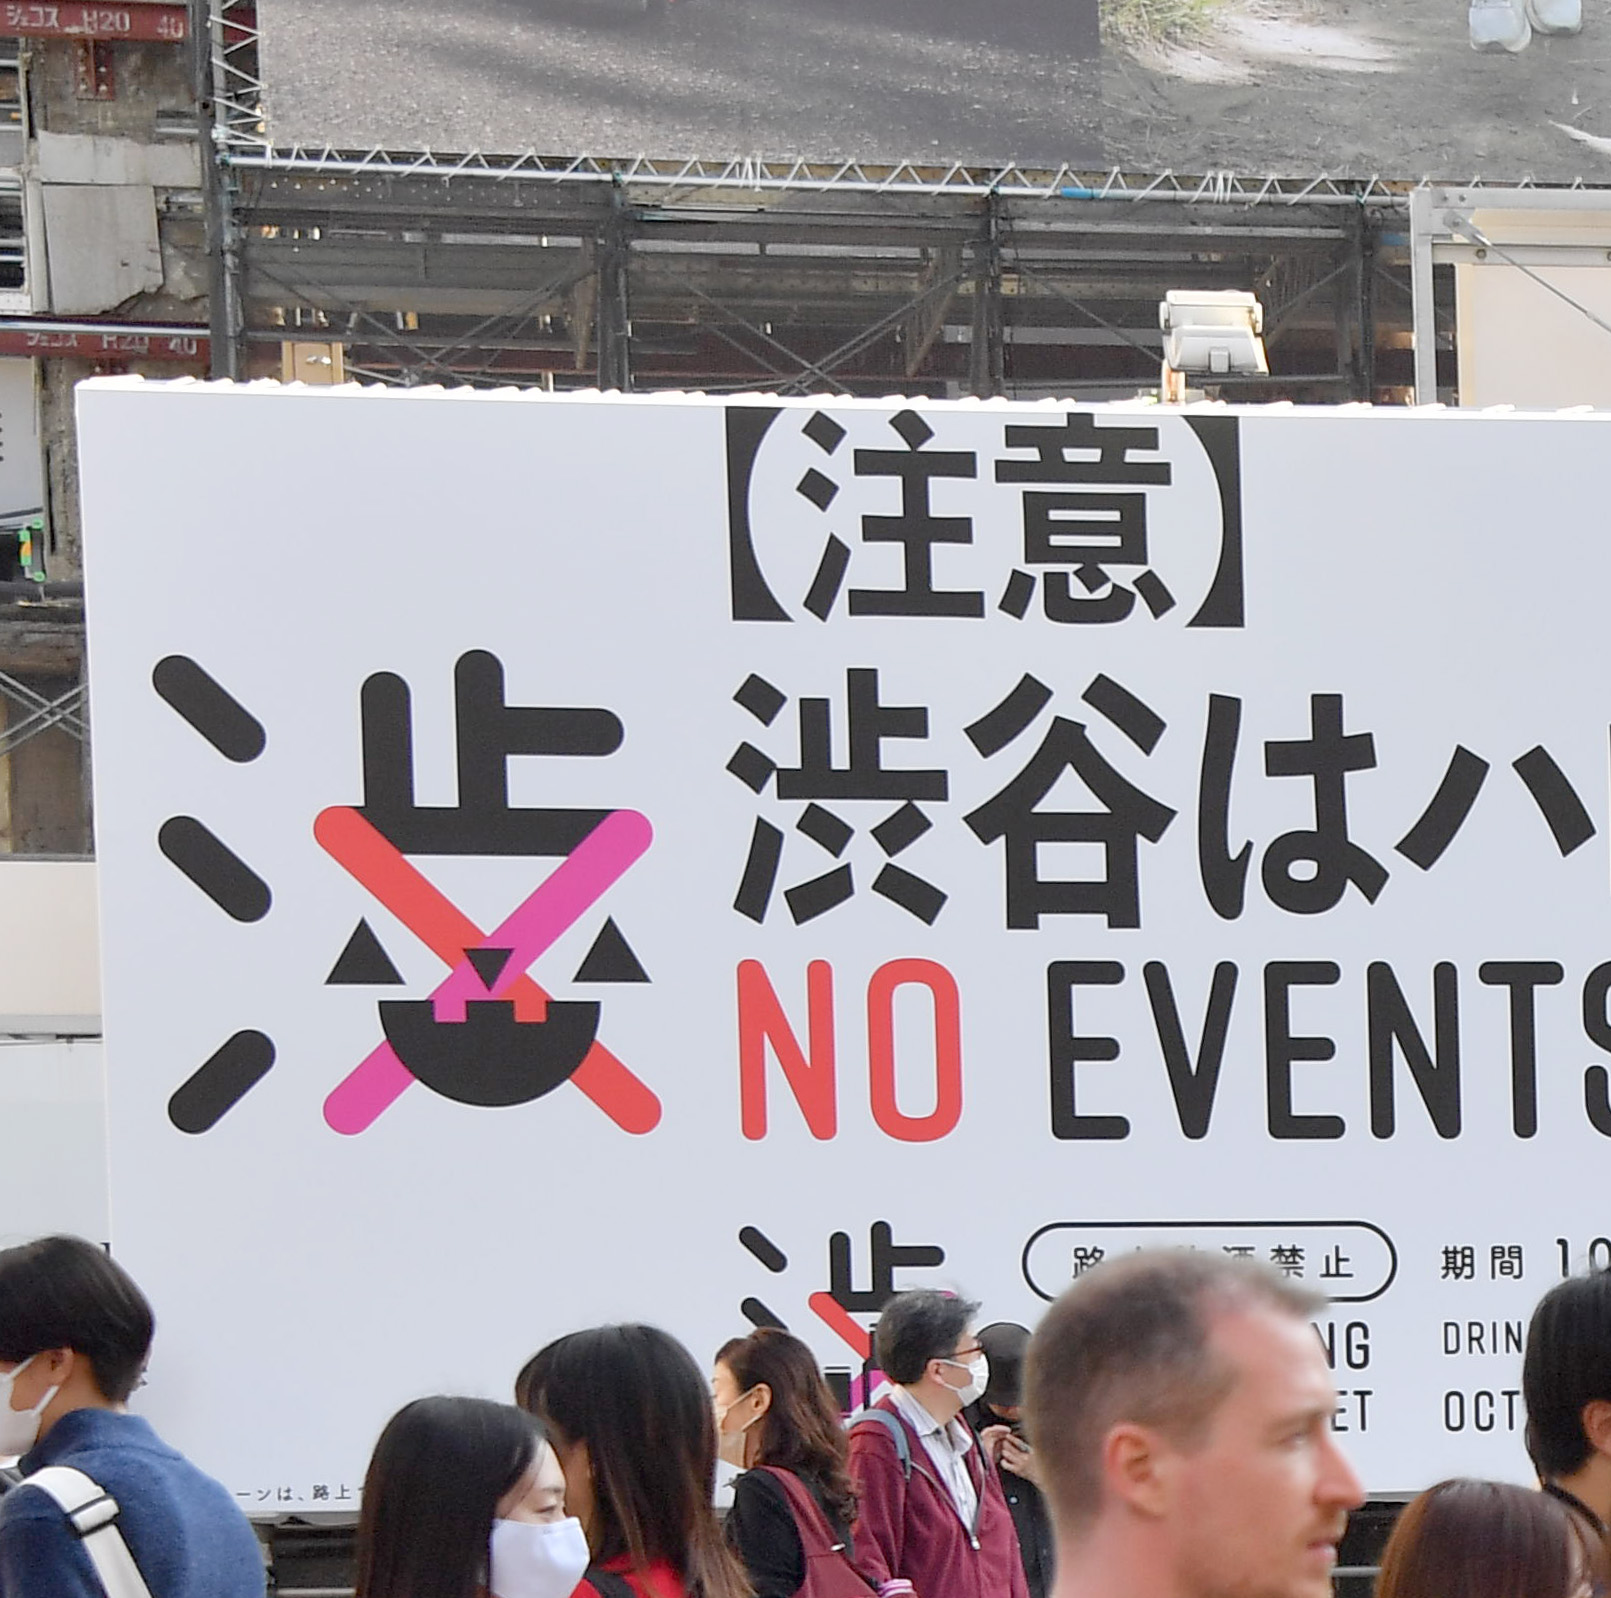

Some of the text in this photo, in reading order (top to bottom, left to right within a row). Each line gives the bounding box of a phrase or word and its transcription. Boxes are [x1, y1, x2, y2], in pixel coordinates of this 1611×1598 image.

[725, 406, 1244, 627] 【注意】
[736, 958, 963, 1142] NO
[236, 1484, 364, 1501] ーンは、路上
